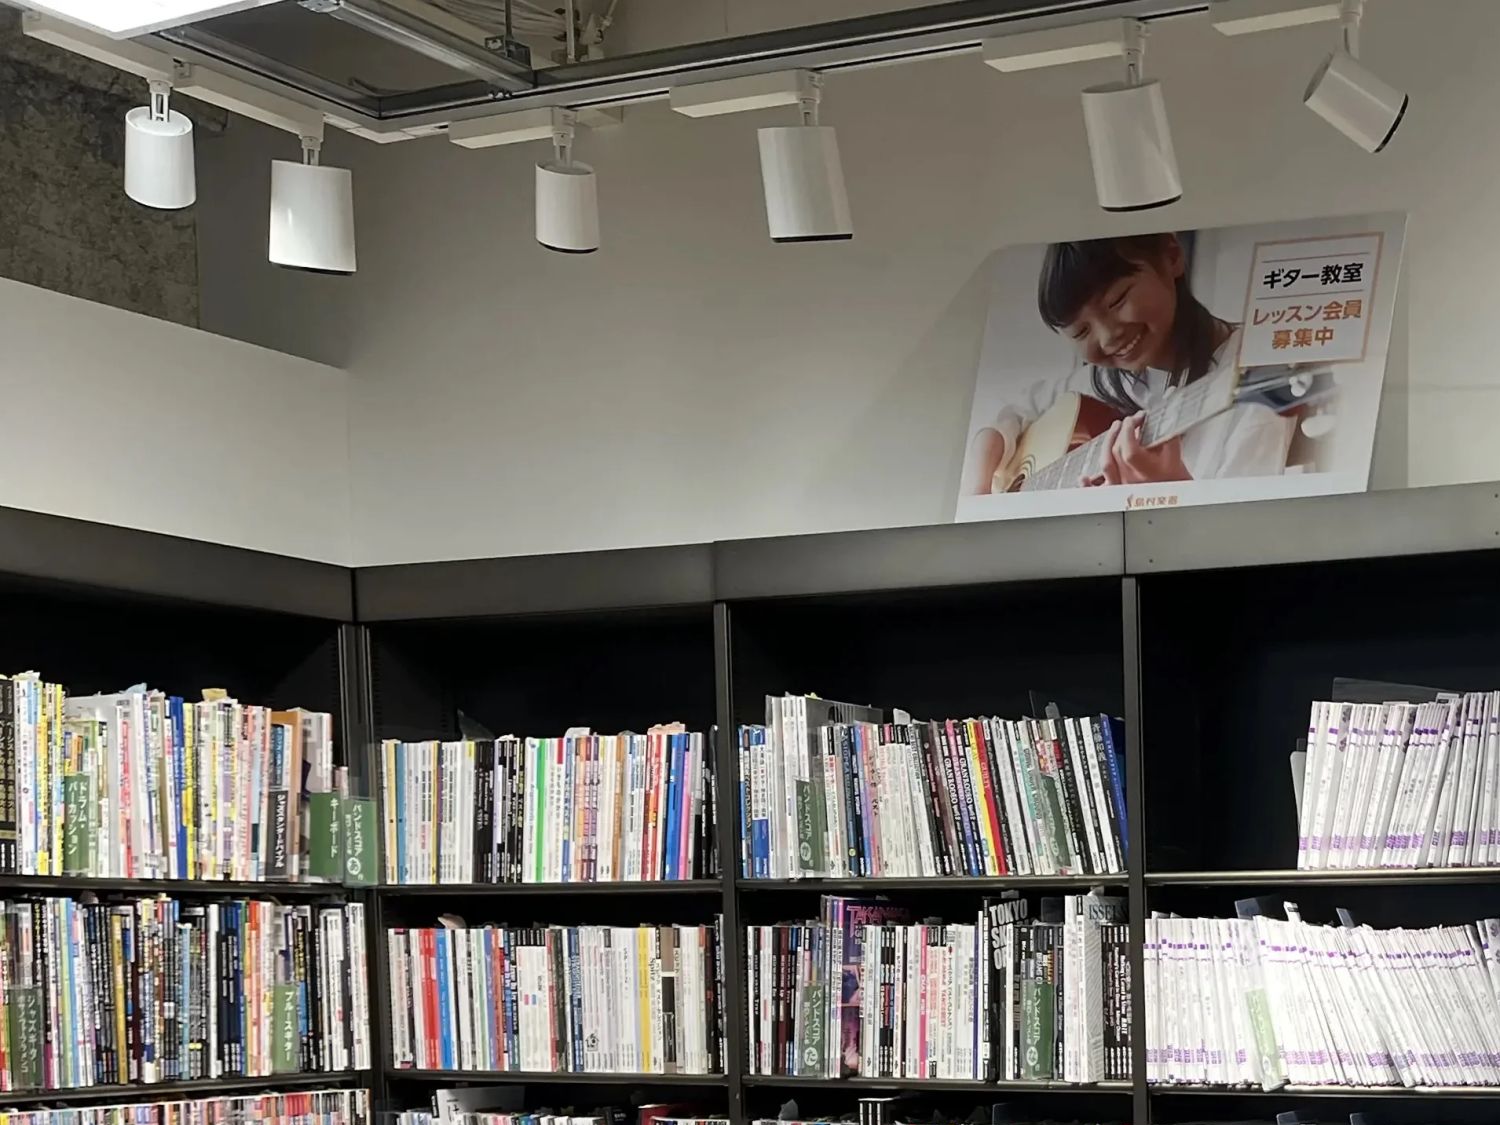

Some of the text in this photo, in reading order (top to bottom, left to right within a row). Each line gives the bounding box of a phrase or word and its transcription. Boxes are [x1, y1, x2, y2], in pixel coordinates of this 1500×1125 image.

[1262, 262, 1364, 290] ギター教室
[1252, 299, 1363, 326] レッスン会員
[1271, 326, 1335, 350] 募集中
[329, 797, 339, 859] キーボード
[352, 804, 363, 857] バンドスコア
[988, 898, 1029, 924] TOKYO
[284, 991, 294, 1062] ブルースギター
[812, 989, 822, 1046] バンドスコア
[1033, 986, 1042, 1047] バンドスコア
